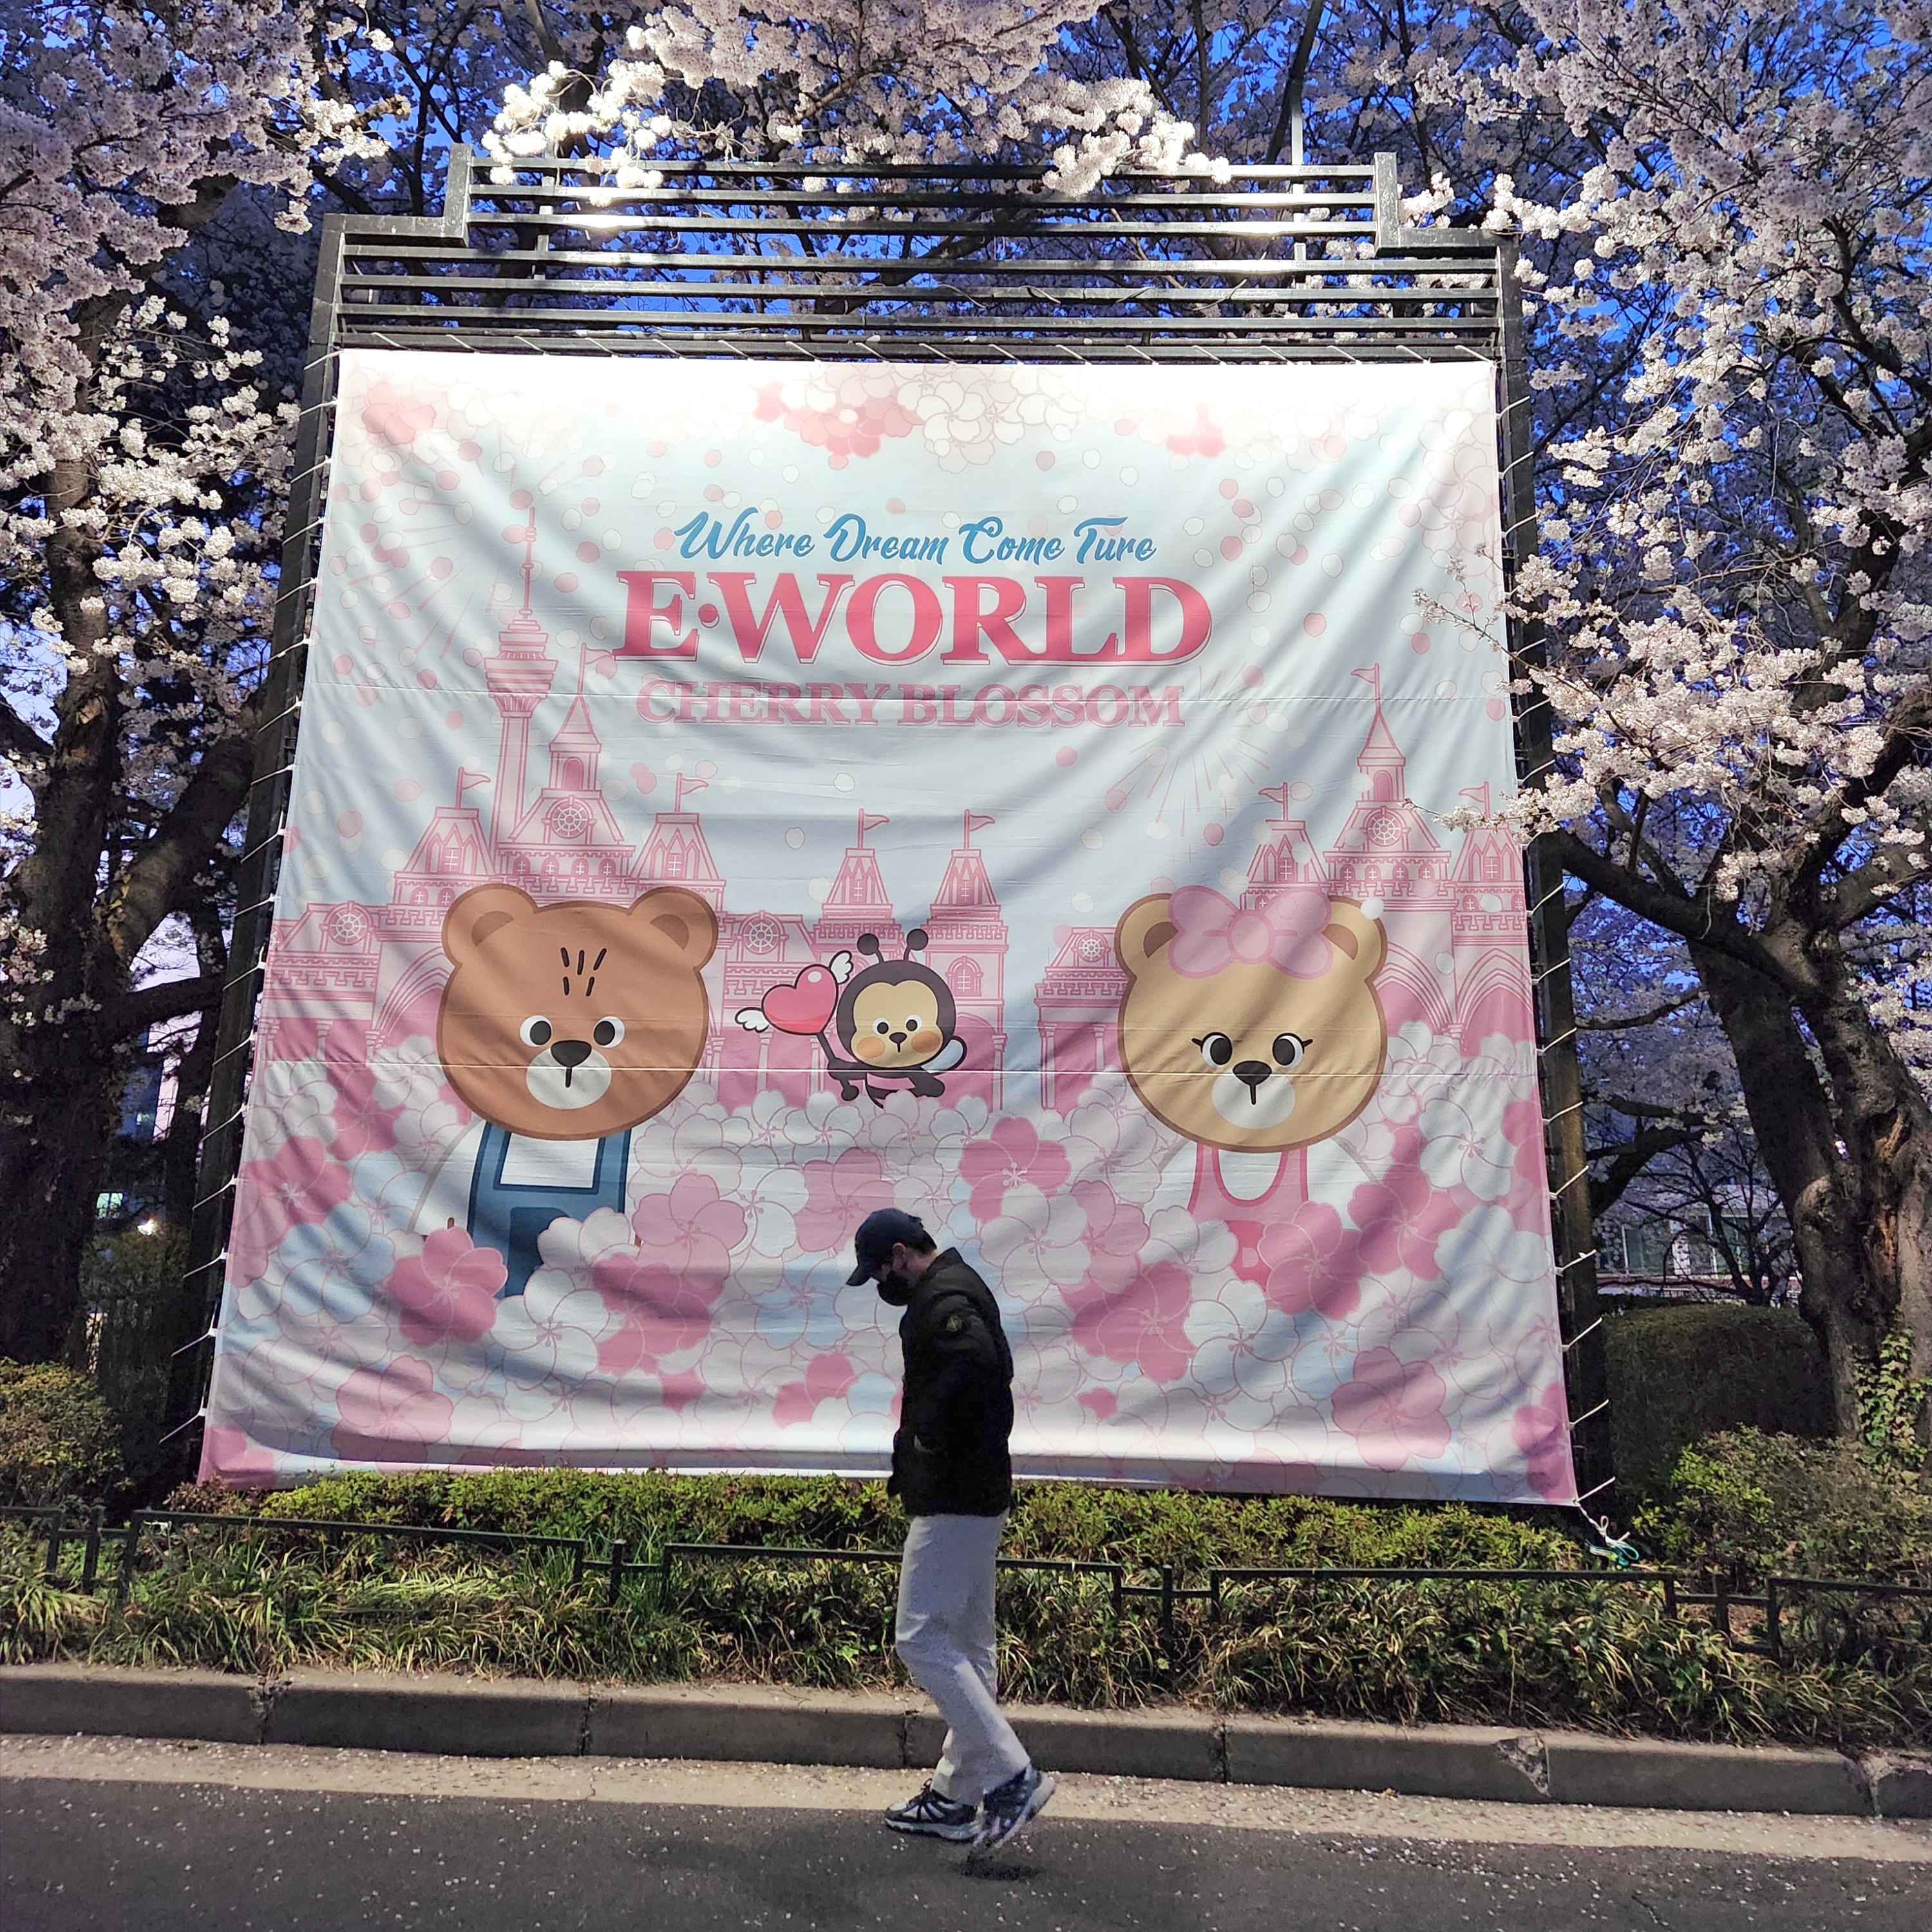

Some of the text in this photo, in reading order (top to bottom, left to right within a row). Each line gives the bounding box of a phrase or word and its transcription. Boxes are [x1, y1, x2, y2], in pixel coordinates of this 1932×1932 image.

[674, 507, 1157, 565] Where Dream Come Ture
[635, 680, 1186, 728] CHERRY BLOSSOM
